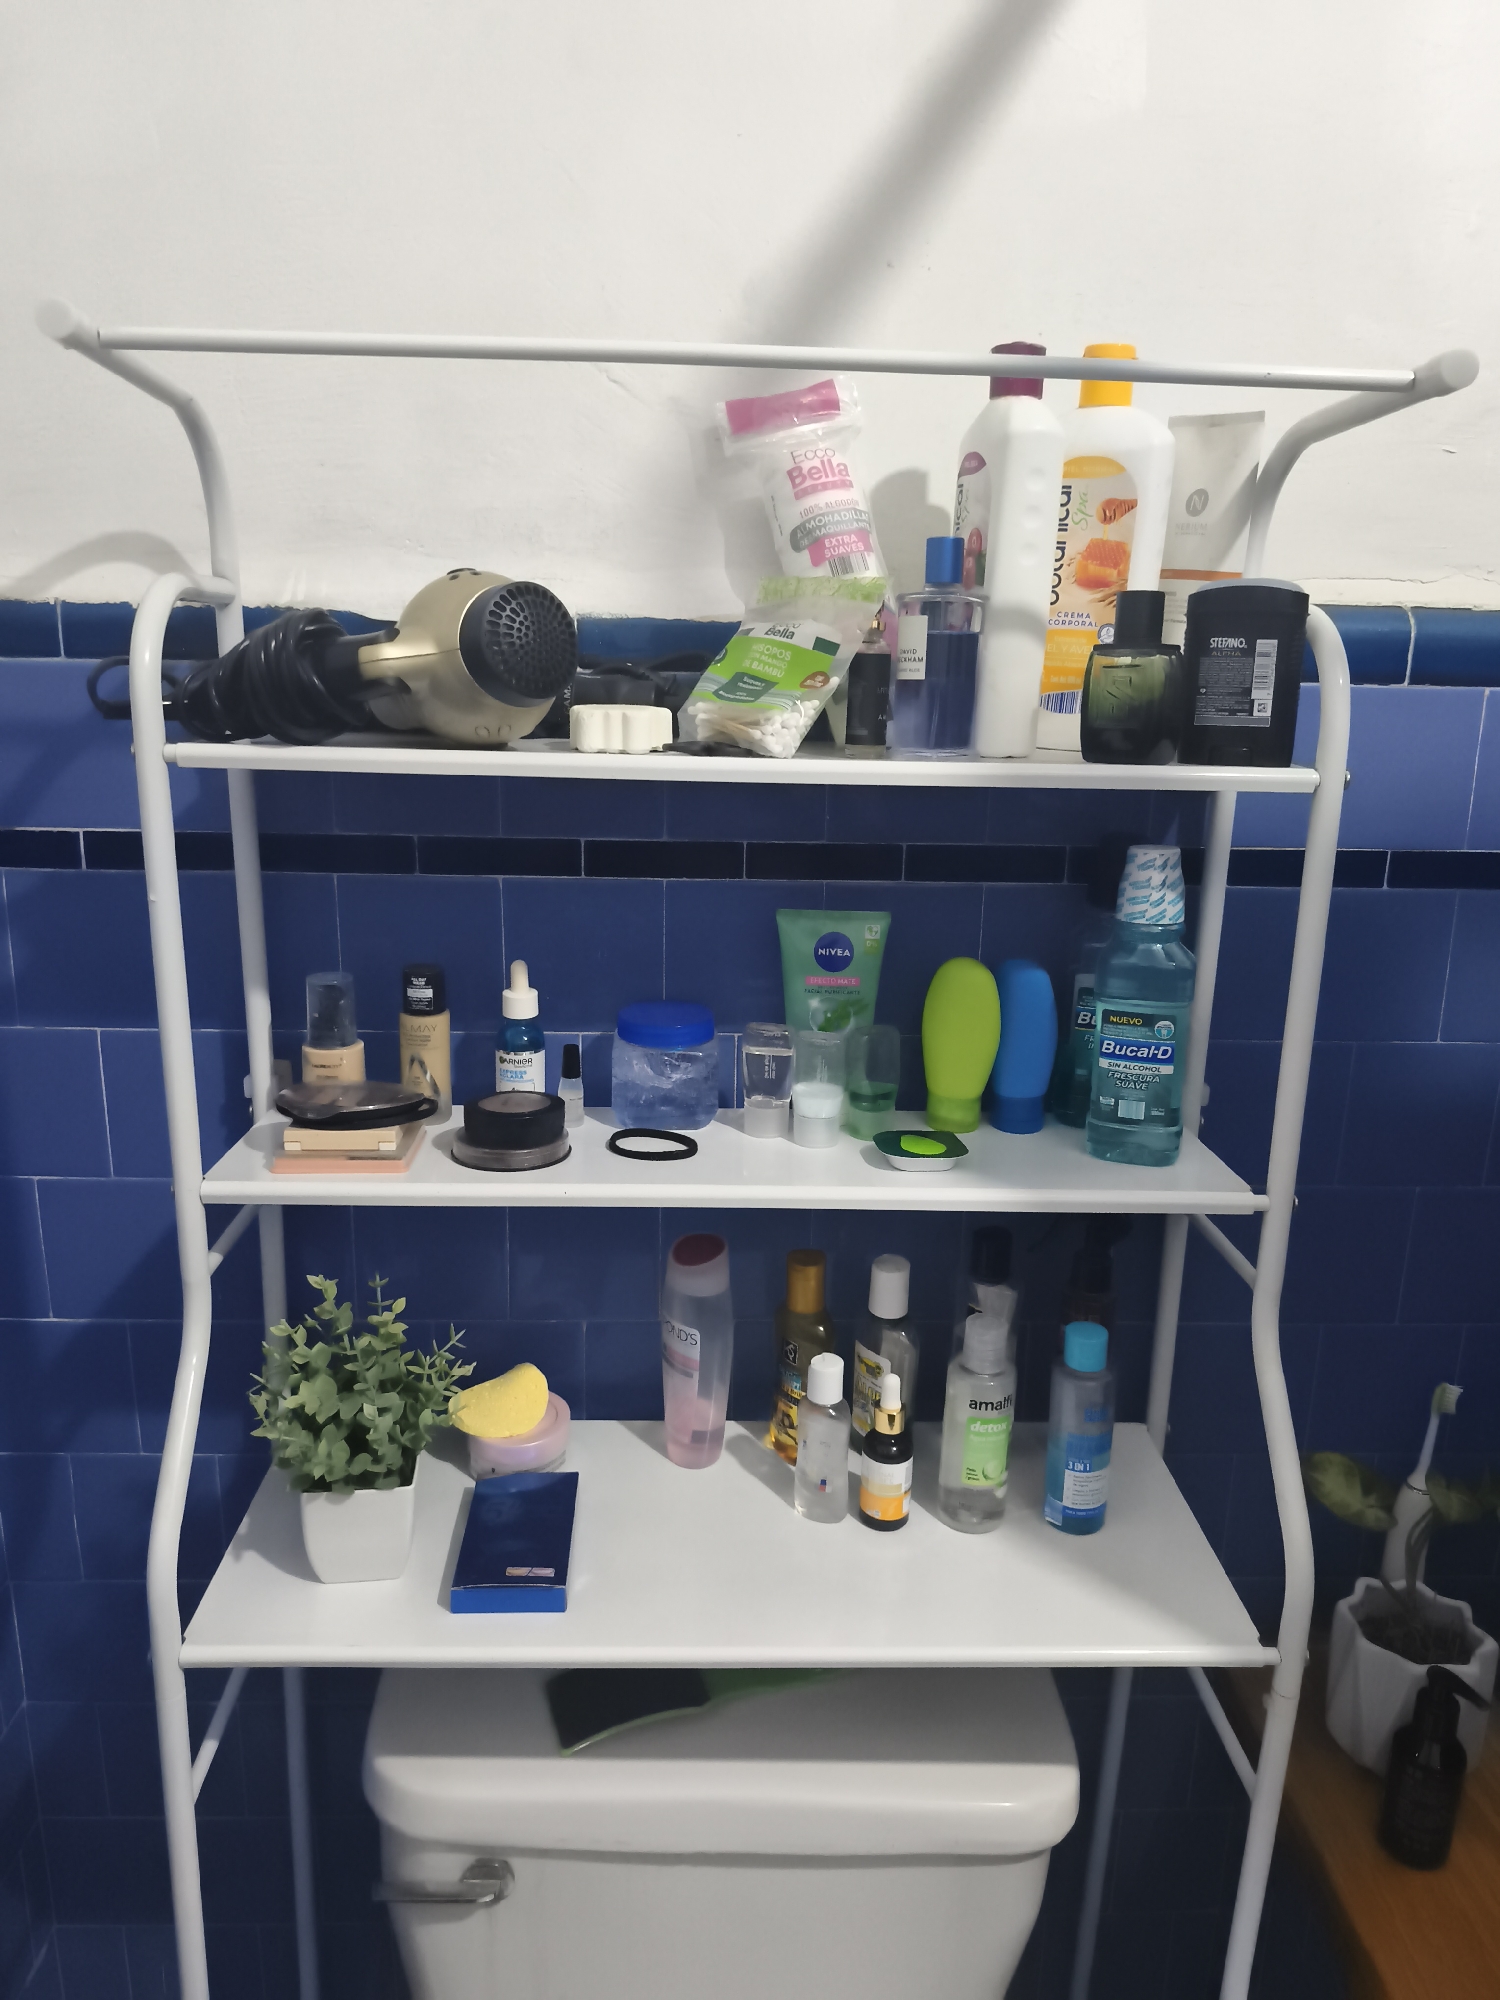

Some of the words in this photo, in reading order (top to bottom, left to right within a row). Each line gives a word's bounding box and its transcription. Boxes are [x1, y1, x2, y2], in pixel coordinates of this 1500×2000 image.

[786, 458, 850, 490] Bella
[799, 503, 824, 519] 100%
[824, 534, 858, 548] EXTRA
[824, 542, 865, 558] SUAVES
[1056, 611, 1091, 619] CREMA
[1048, 618, 1098, 628] CORPORAL
[764, 627, 795, 640] Bella
[1210, 637, 1246, 649] STEFANO
[818, 948, 851, 957] NIVEA
[810, 977, 837, 985] EFECTO
[1109, 1015, 1143, 1026] NUEVO
[1101, 1040, 1172, 1059] Bucal-D
[1107, 1061, 1121, 1069] SIN
[1122, 1064, 1162, 1073] ALCOHOL
[1108, 1071, 1160, 1083] FRESCURA
[1115, 1080, 1149, 1090] SUAVE
[665, 1320, 698, 1346] OND'S
[969, 1393, 1013, 1411] amalfi
[970, 1420, 1008, 1433] detox
[1068, 1461, 1073, 1469] 3
